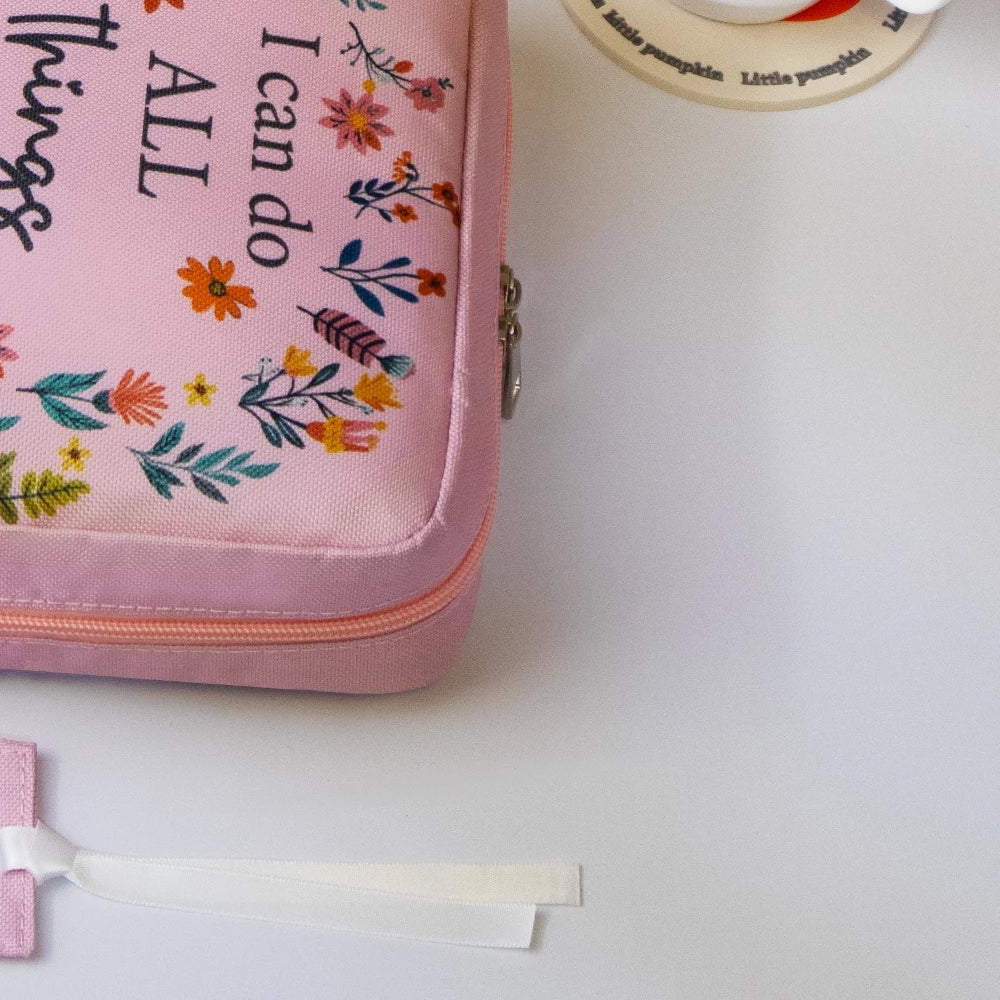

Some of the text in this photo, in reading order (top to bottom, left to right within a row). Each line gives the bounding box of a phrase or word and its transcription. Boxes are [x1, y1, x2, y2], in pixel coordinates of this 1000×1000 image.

[602, 8, 724, 82] Little pumpkin
[740, 47, 872, 87] Little pumpkin
[137, 50, 217, 199] ALL
[246, 27, 321, 268] I can do
